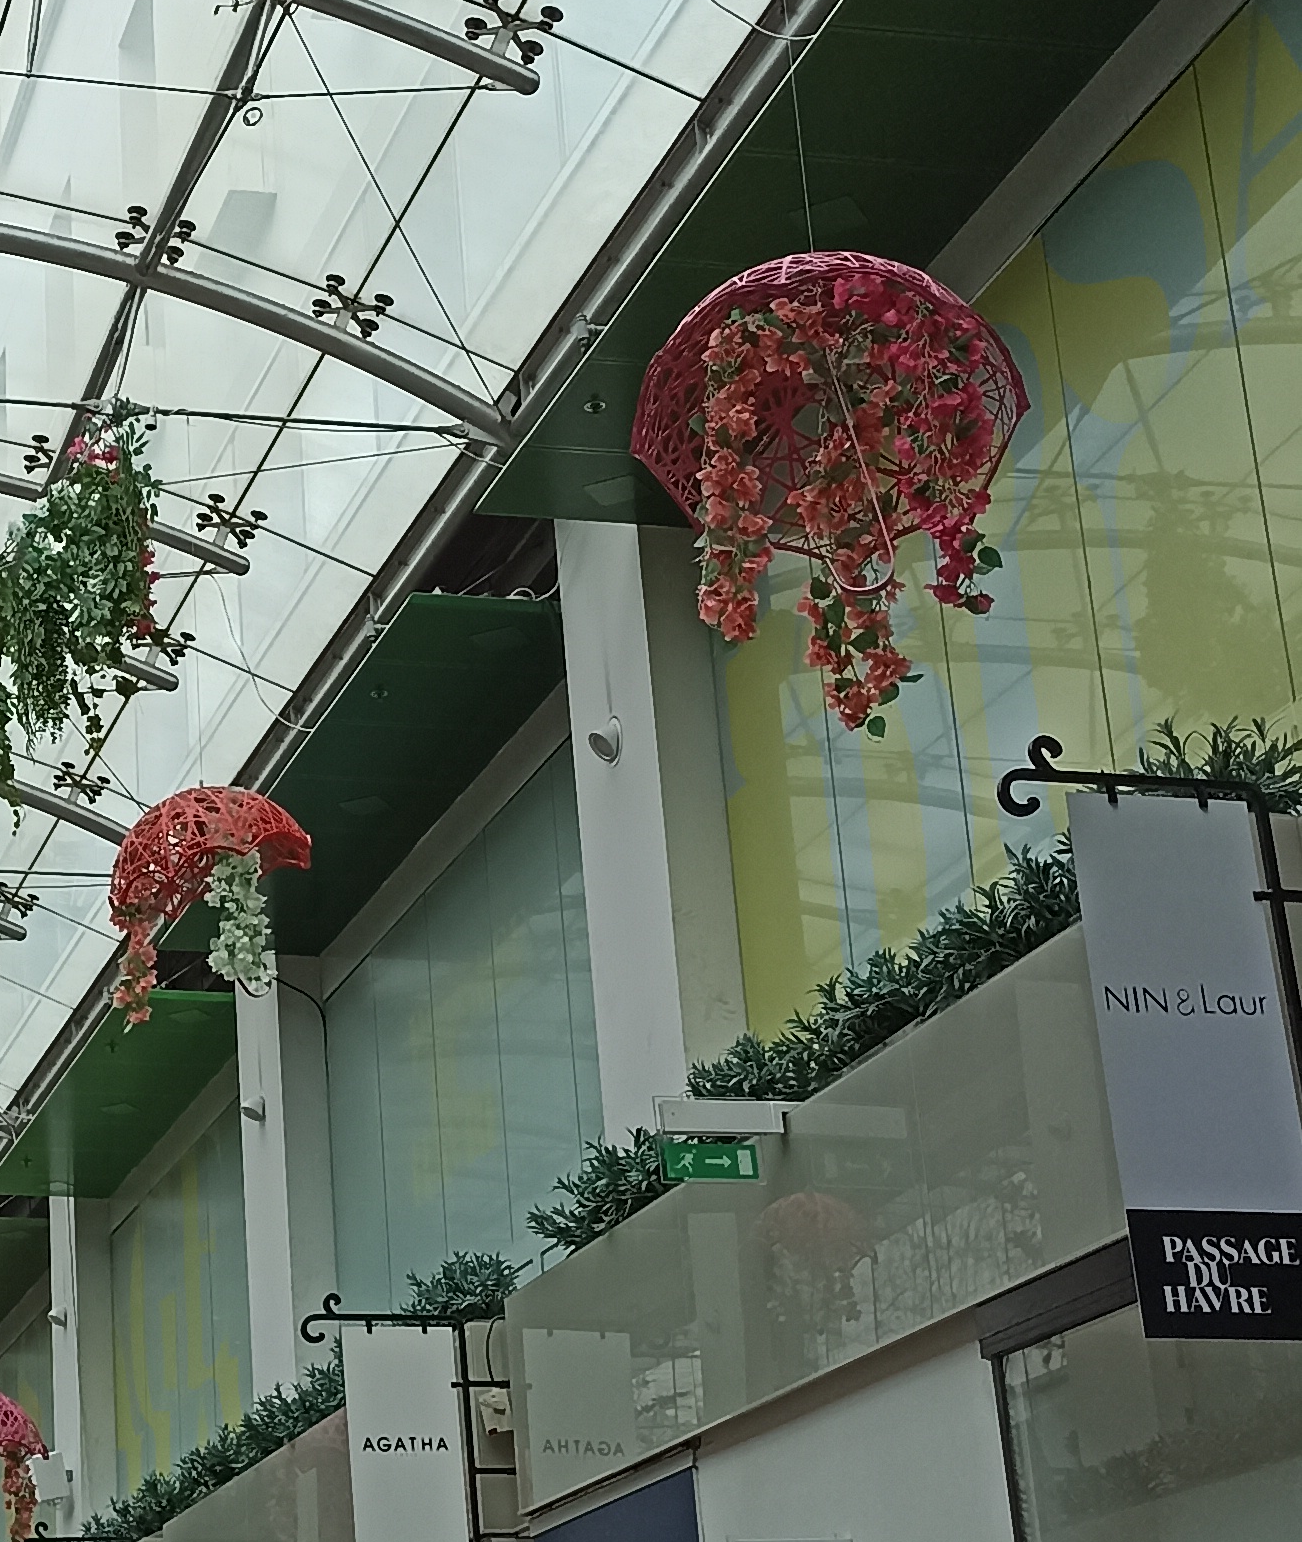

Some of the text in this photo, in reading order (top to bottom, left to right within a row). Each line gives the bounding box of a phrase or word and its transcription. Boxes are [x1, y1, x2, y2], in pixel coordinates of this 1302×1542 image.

[1104, 984, 1266, 1016] NIN & Laur
[1162, 1235, 1300, 1265] PASSAGE
[1185, 1260, 1231, 1288] DU
[1163, 1285, 1272, 1314] HAVRE
[362, 1436, 449, 1453] AGATHA
